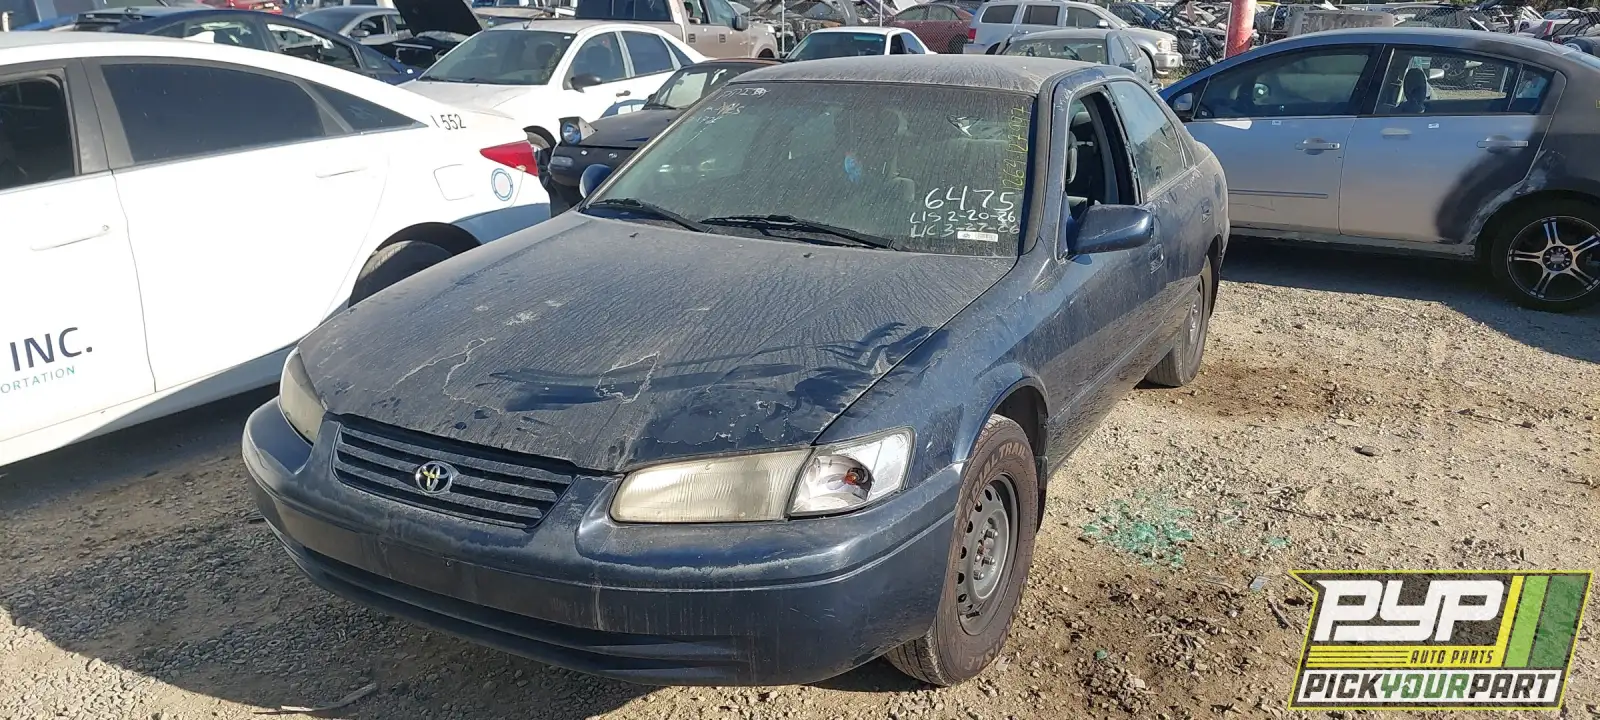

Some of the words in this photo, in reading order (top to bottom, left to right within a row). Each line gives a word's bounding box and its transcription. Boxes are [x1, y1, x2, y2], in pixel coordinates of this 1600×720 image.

[924, 185, 1014, 211] 6475
[947, 209, 1016, 223] 2-20-26
[940, 222, 1020, 238] 3-27-26
[9, 326, 93, 372] INC.
[0, 365, 76, 394] ORTATION
[998, 442, 1027, 461] TRAIL
